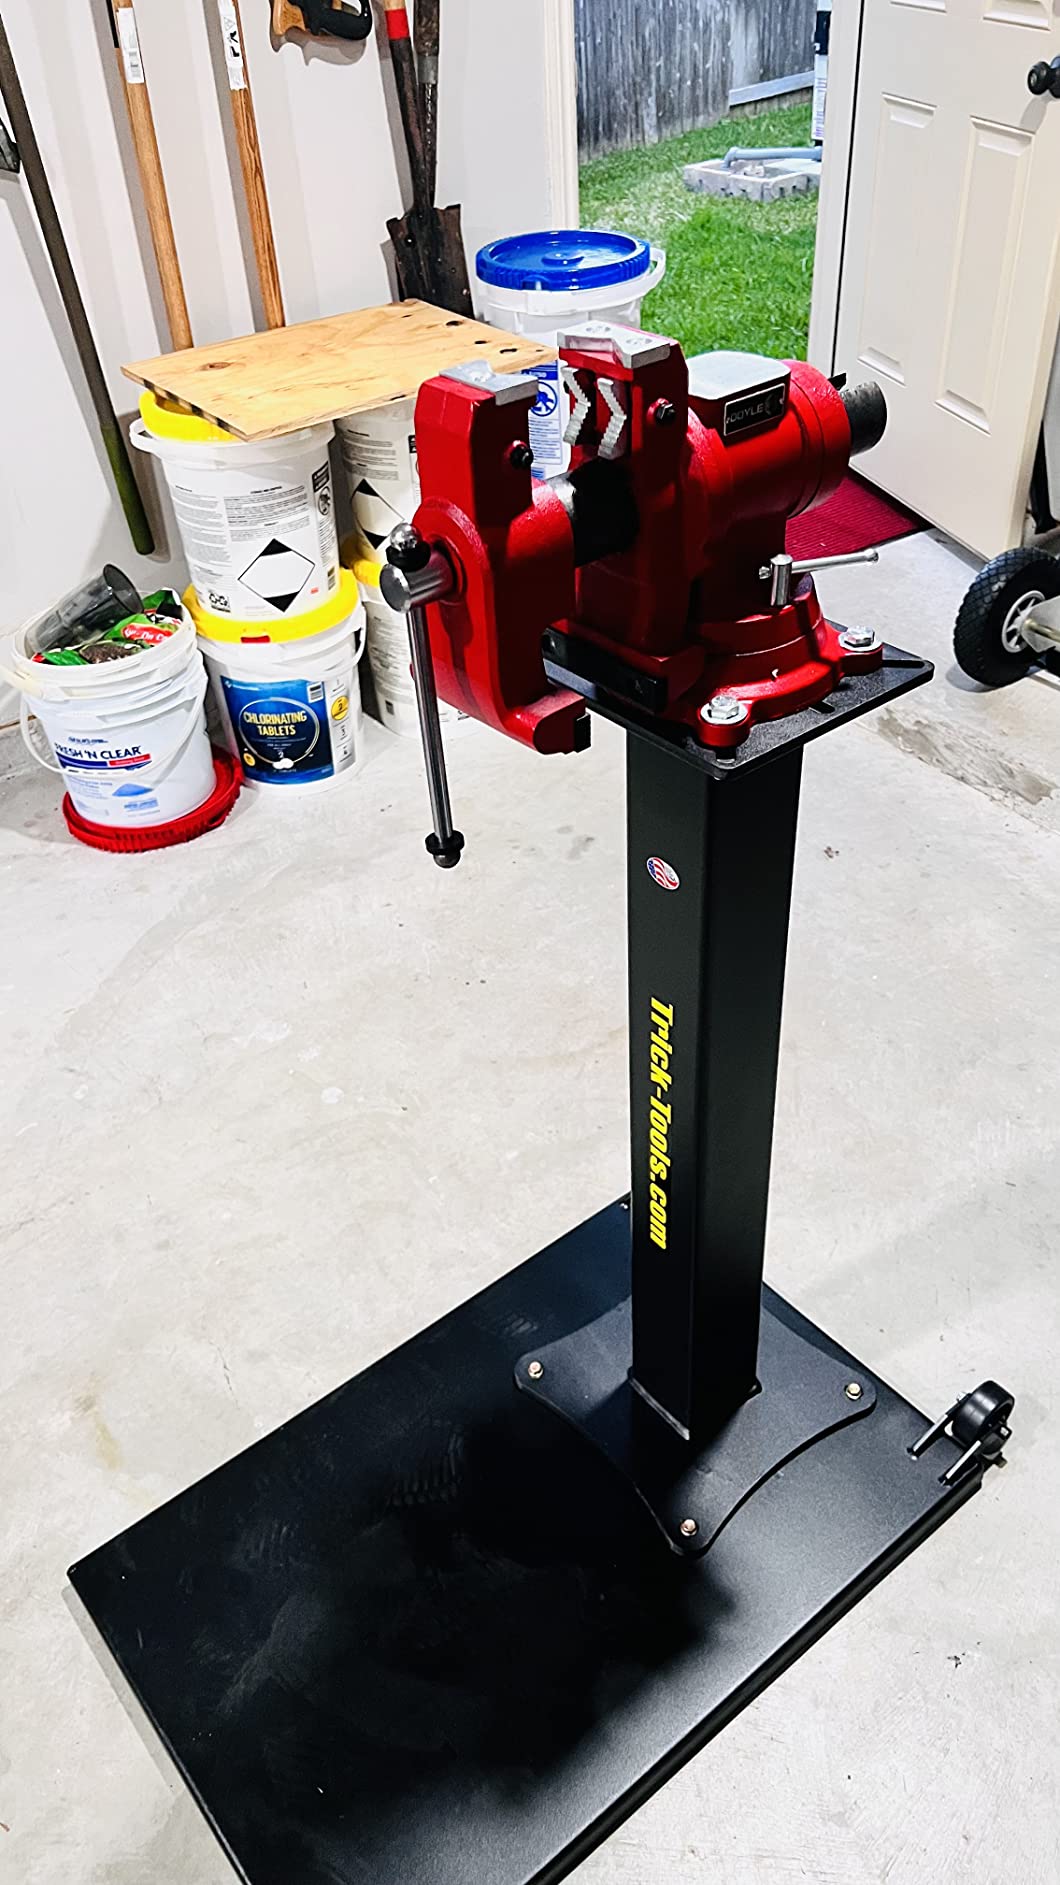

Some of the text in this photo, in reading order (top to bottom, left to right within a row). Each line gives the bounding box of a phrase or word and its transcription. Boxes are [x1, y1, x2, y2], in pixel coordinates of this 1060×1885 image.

[730, 402, 764, 423] DOYLE
[243, 710, 308, 725] CHLORINATING
[257, 724, 297, 737] TABLETS
[100, 746, 142, 760] CLEAR
[650, 996, 674, 1250] Trick-Tools.com
